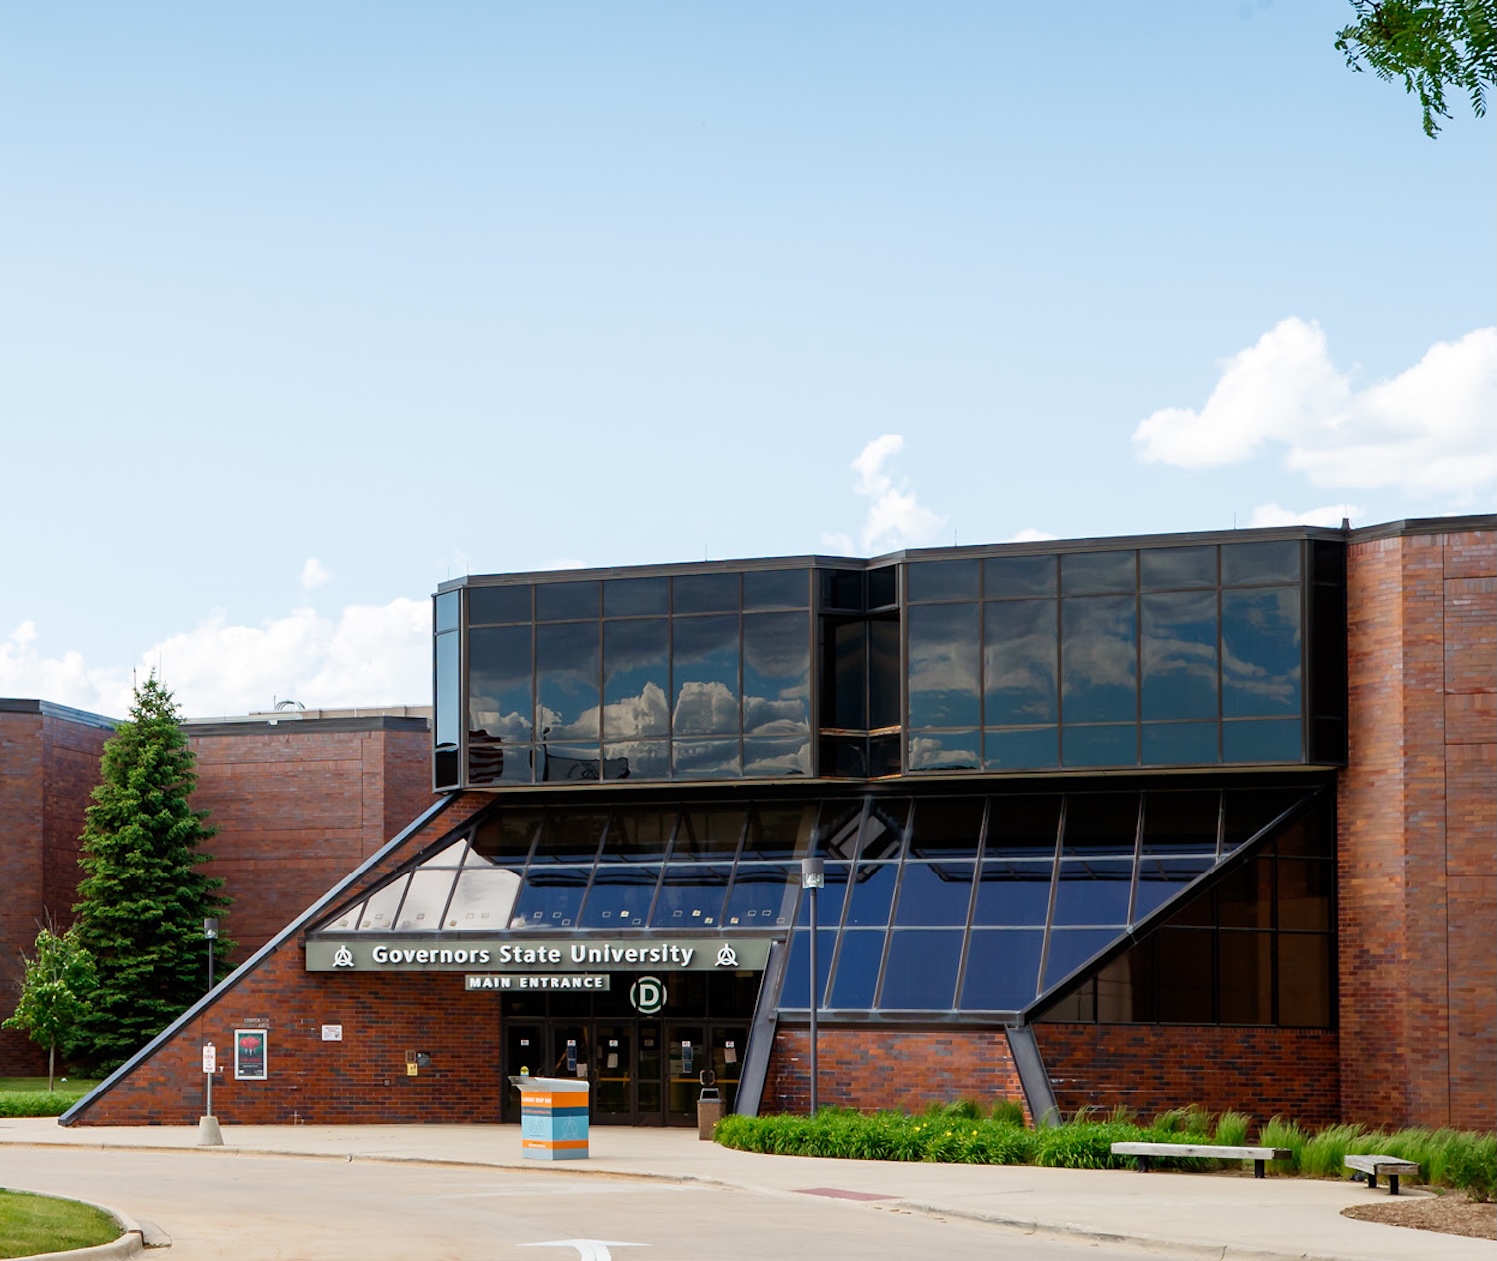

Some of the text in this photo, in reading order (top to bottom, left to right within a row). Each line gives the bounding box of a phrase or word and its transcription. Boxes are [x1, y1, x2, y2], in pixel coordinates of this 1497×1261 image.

[372, 944, 695, 967] Governors State University
[469, 977, 603, 989] MAIN ENTRANCE
[639, 983, 659, 1007] D
